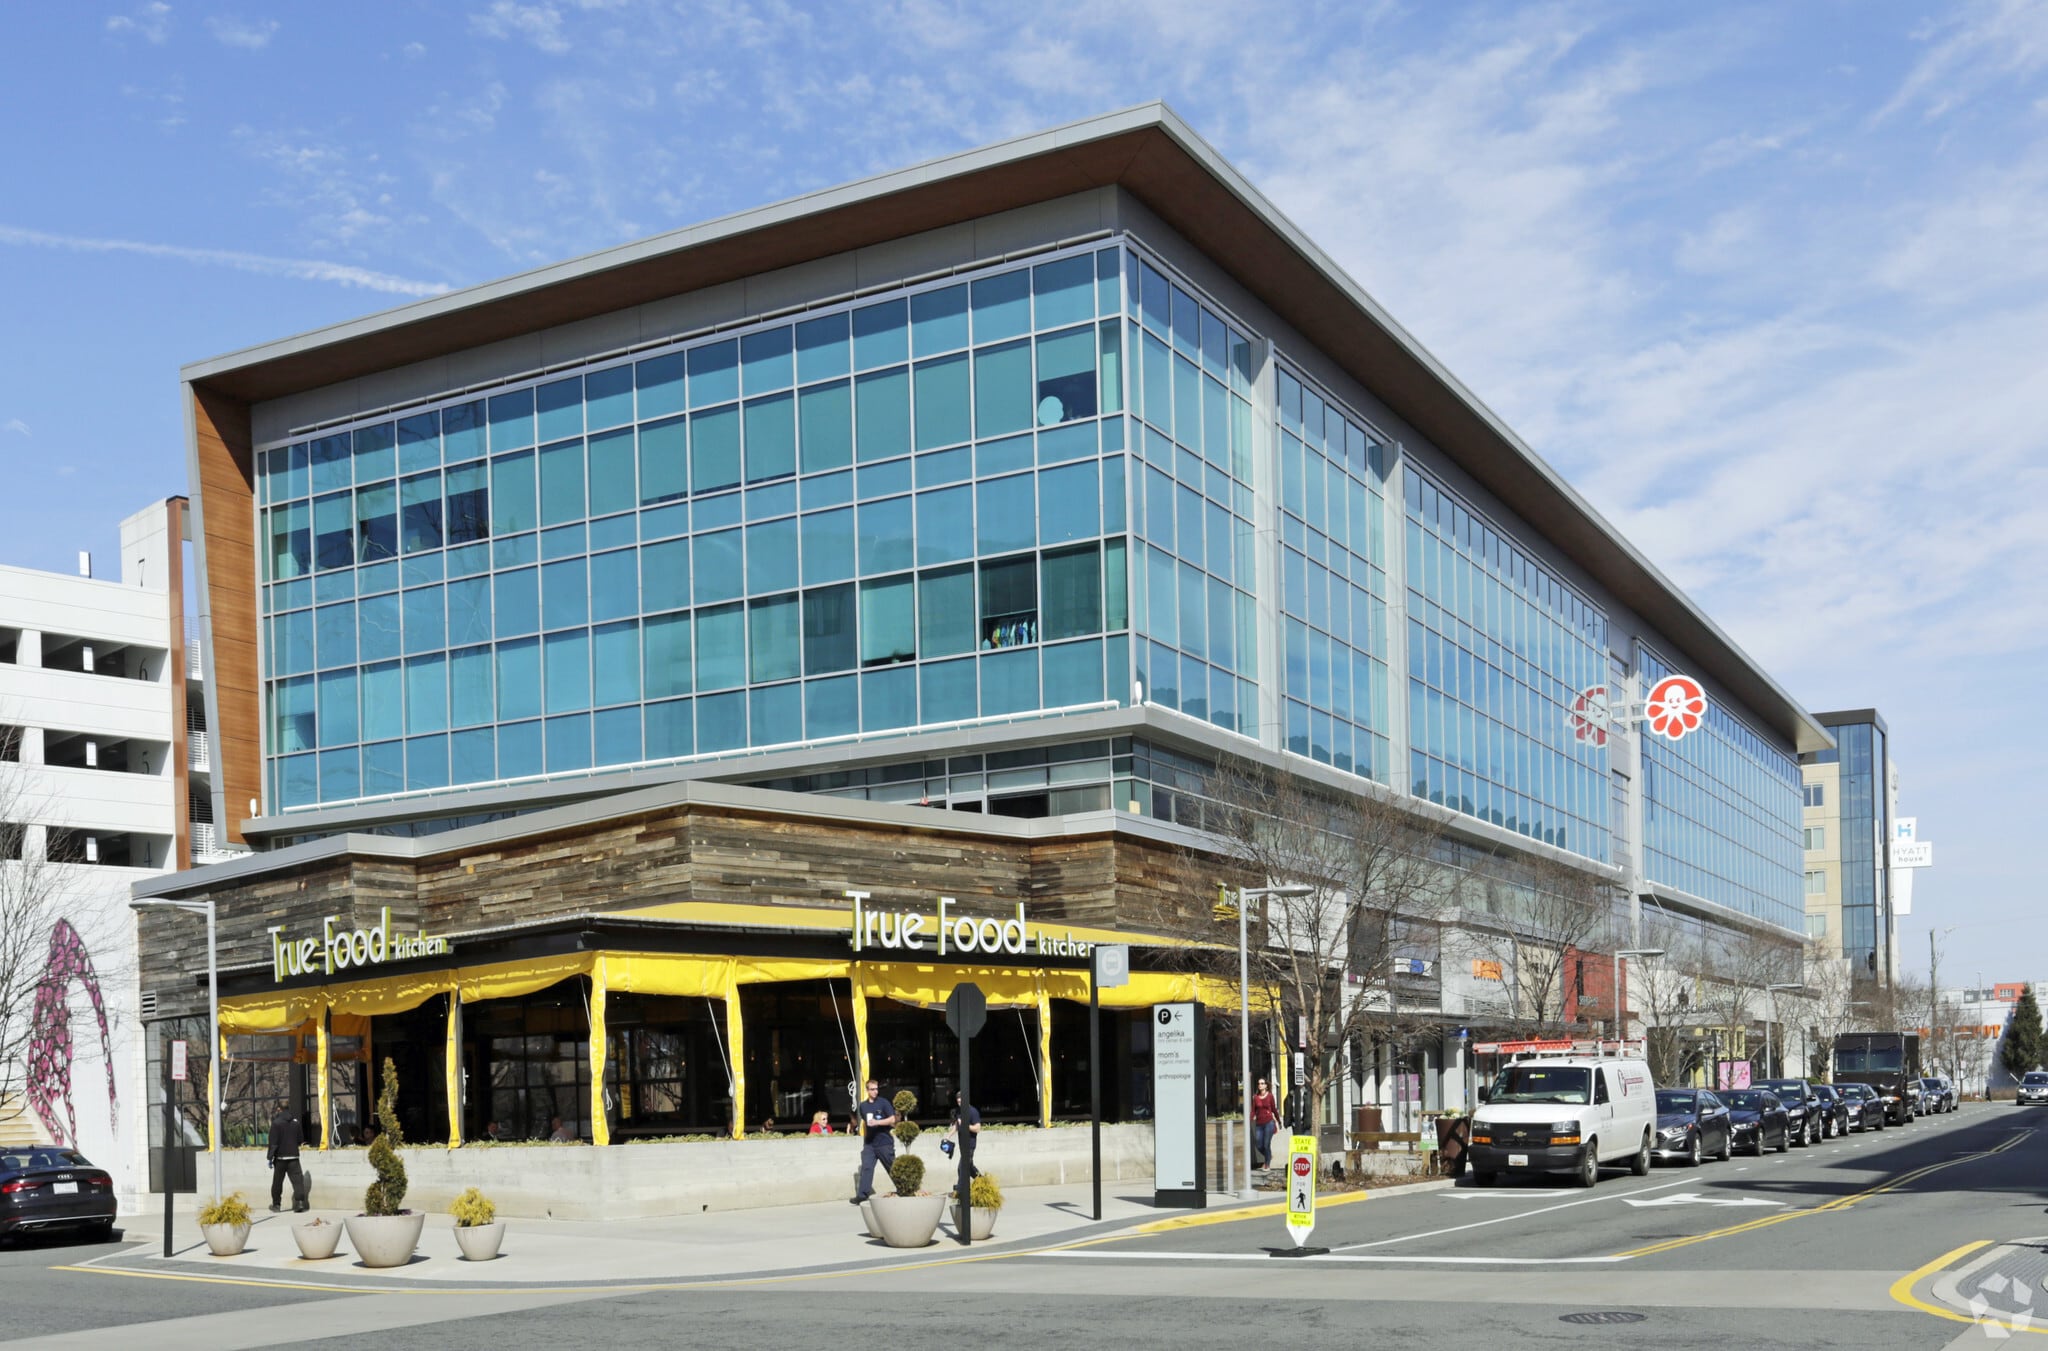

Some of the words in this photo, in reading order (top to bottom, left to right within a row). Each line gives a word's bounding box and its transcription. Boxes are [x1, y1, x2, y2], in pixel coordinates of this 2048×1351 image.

[138, 558, 145, 587] 7
[139, 657, 148, 680] 6
[142, 750, 150, 775] 5
[143, 841, 152, 868] 4
[1893, 847, 1928, 856] HYATT
[841, 890, 925, 952] True
[936, 896, 1026, 955] Food
[267, 925, 320, 983] True
[324, 906, 392, 976] Food
[395, 929, 447, 960] kitchen
[1158, 1030, 1185, 1040] angelika
